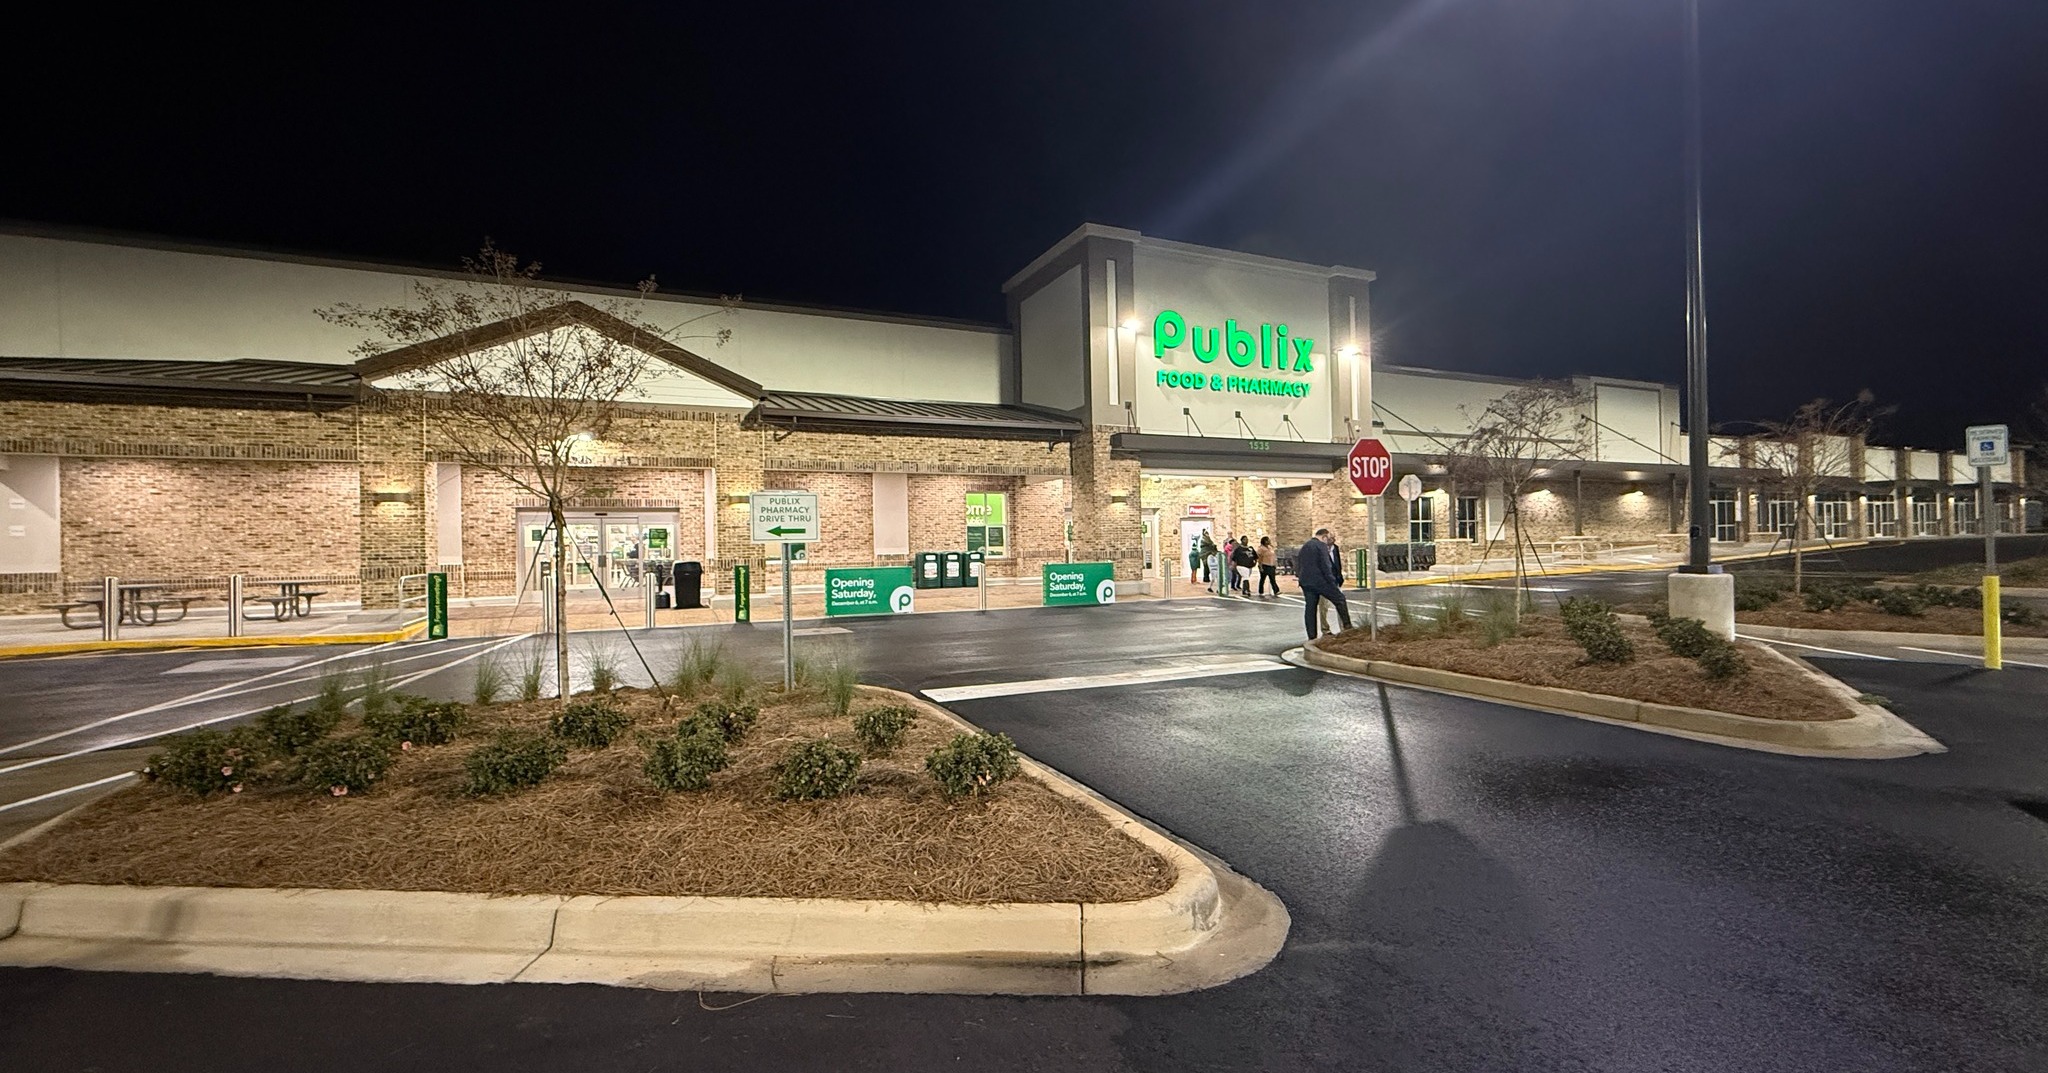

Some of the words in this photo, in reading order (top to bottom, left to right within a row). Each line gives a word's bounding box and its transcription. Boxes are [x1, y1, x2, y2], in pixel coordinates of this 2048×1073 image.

[1154, 310, 1313, 372] Publix
[1157, 370, 1207, 389] FOOD
[1211, 373, 1223, 391] &
[1227, 375, 1311, 398] PHARMACY
[1248, 441, 1270, 451] 1535
[1352, 456, 1389, 478] STOP
[769, 497, 801, 505] PUBLIX
[760, 506, 810, 514] PHARMACY
[1049, 571, 1084, 583] Opening
[831, 577, 875, 590] Opening
[1049, 582, 1086, 592] Saturday,
[831, 588, 877, 600] Saturday,
